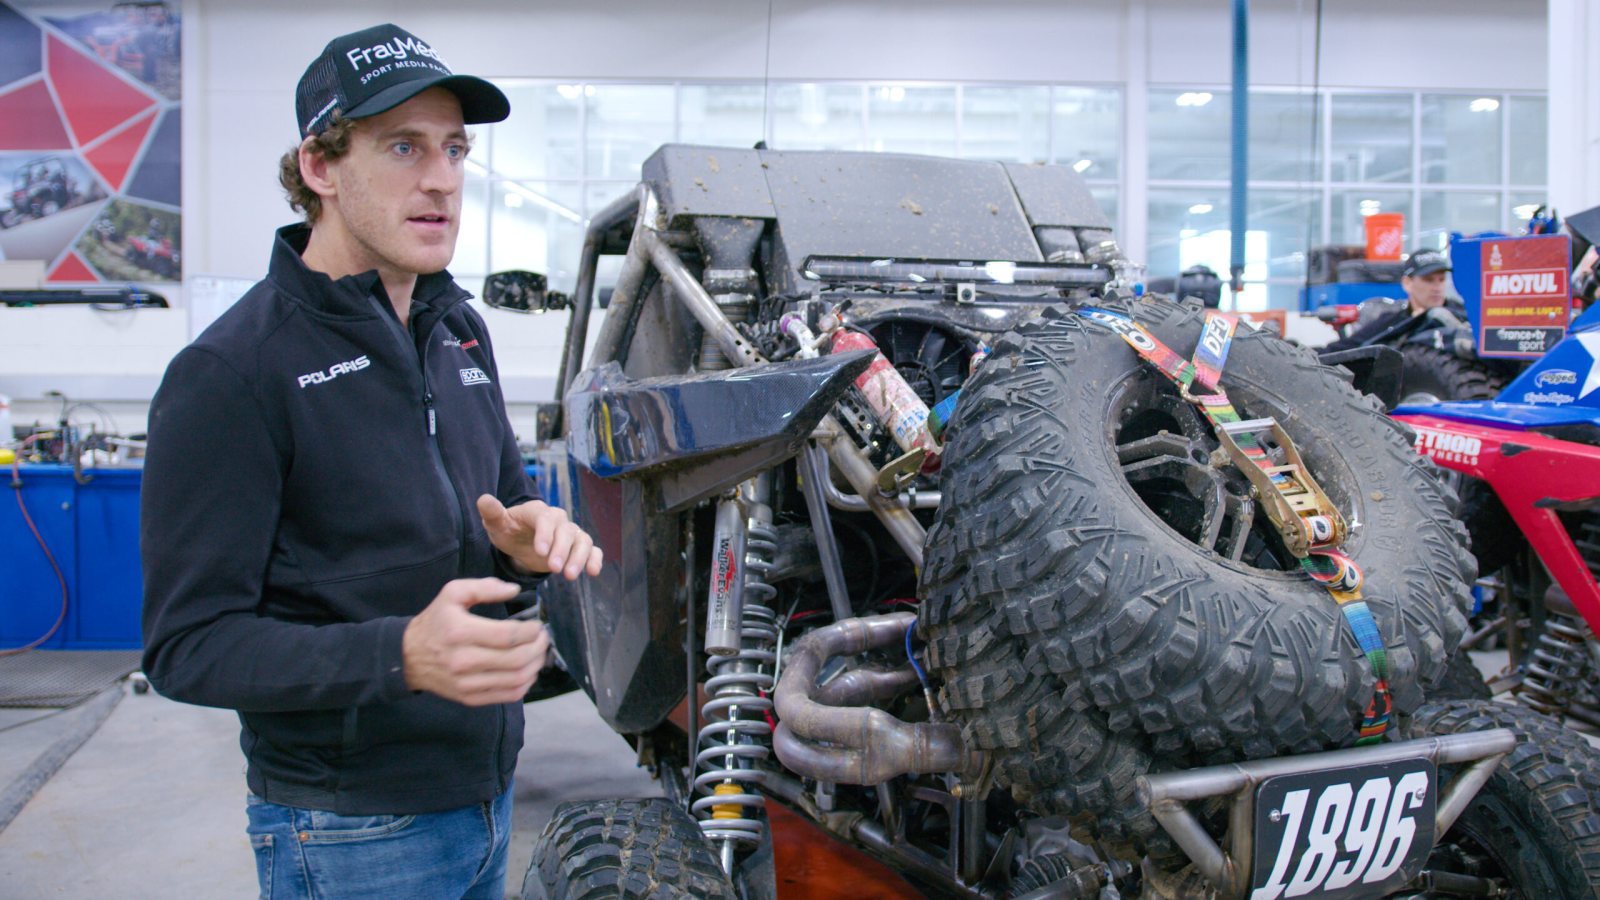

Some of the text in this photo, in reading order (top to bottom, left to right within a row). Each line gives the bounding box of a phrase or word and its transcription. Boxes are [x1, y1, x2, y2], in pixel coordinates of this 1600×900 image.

[360, 63, 392, 84] SPORT
[395, 61, 427, 69] MEDIA
[1490, 273, 1558, 294] MOTUL
[1204, 315, 1232, 357] DFO
[1518, 340, 1546, 352] sport
[297, 355, 371, 388] POLARIS
[1415, 428, 1482, 456] ETHOD
[717, 538, 730, 577] Walker
[715, 579, 727, 613] Evans
[1251, 771, 1428, 900] 1896
